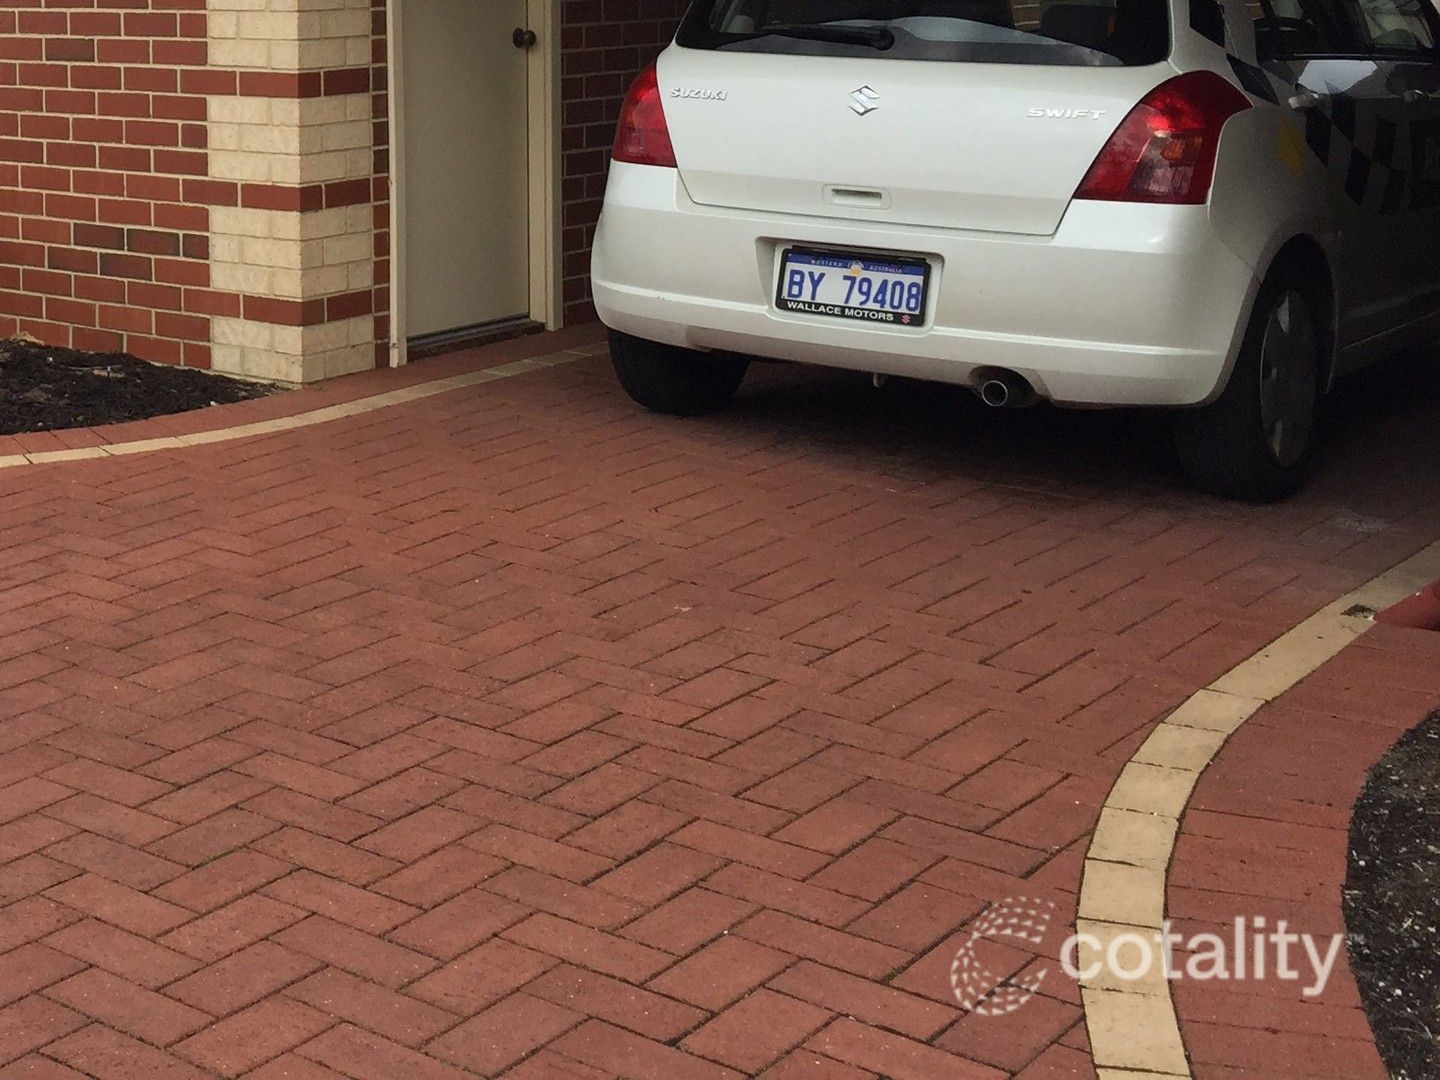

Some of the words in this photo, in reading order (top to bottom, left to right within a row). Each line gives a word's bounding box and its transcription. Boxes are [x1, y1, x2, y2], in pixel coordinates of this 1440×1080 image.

[670, 87, 729, 101] SUZUKI
[1027, 107, 1107, 121] SWIFT
[787, 269, 825, 301] BY
[843, 275, 922, 312] 79408
[787, 301, 842, 315] WALLACE
[845, 308, 894, 321] MOTORS
